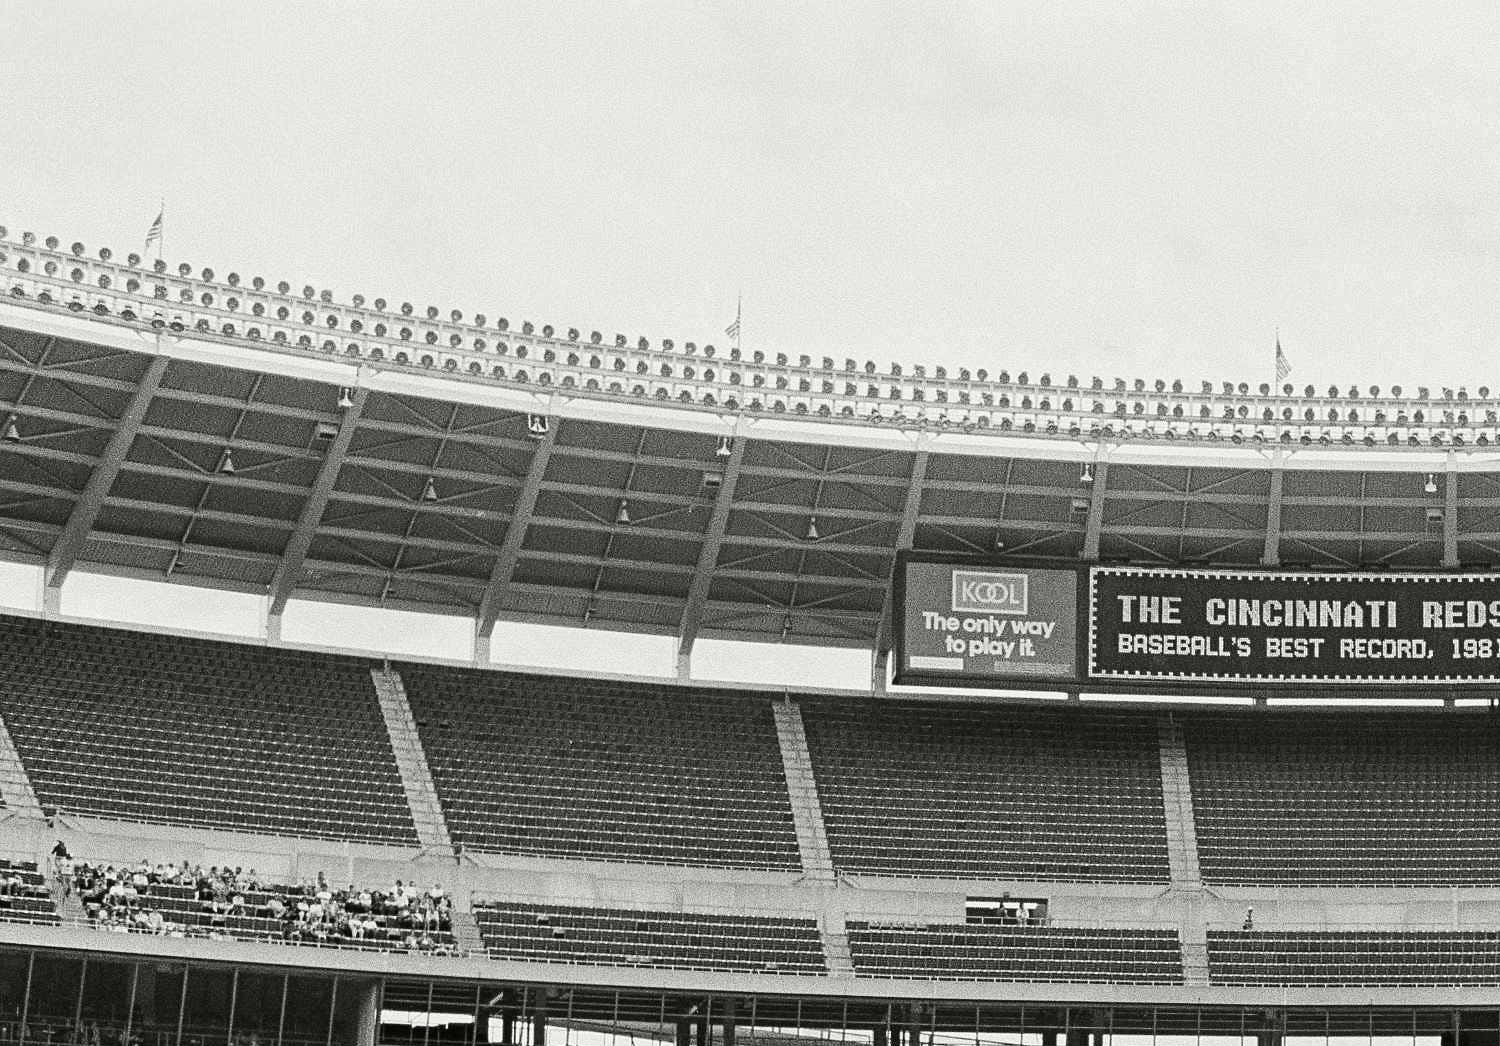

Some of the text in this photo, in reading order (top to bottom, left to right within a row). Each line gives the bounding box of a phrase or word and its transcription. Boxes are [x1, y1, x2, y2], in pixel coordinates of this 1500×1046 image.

[961, 580, 1020, 605] KOOL
[922, 611, 1056, 639] The only way
[1117, 595, 1182, 624] THE
[1206, 598, 1397, 628] CINCINNATI
[945, 635, 1036, 659] to play it.
[1118, 633, 1251, 657] BASEBALL'S
[1265, 637, 1325, 659] BEST
[1339, 637, 1434, 660] RECORD,
